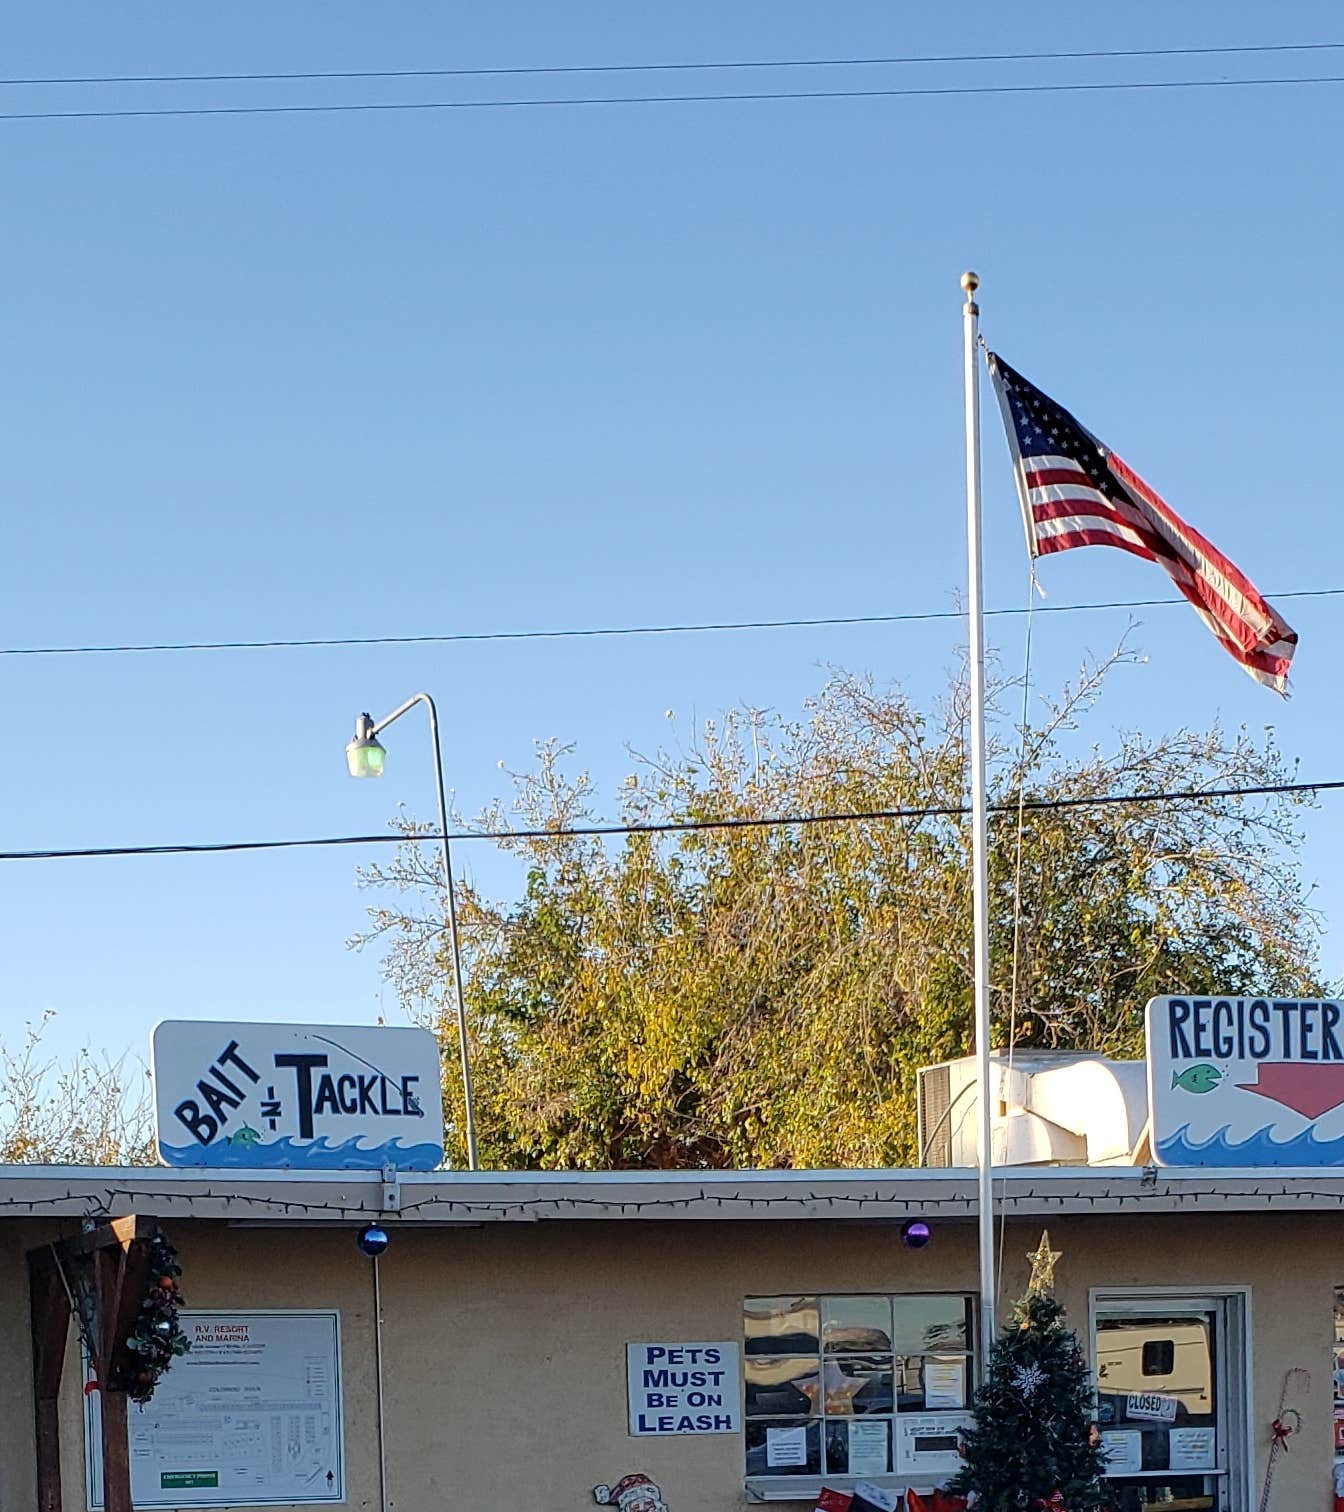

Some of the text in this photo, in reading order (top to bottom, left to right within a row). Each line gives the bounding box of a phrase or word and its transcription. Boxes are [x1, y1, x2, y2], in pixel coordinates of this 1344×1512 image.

[1169, 1000, 1344, 1060] REGISTER
[174, 1040, 261, 1146] BAIT
[274, 1054, 421, 1140] TACKLE
[195, 1334, 250, 1342] AND MARINA
[214, 1325, 249, 1333] RESORT
[646, 1346, 721, 1365] PETS
[643, 1369, 725, 1388] MUST
[647, 1392, 722, 1408] BE ON
[1129, 1393, 1162, 1411] CLOSED
[638, 1414, 732, 1432] LEASH
